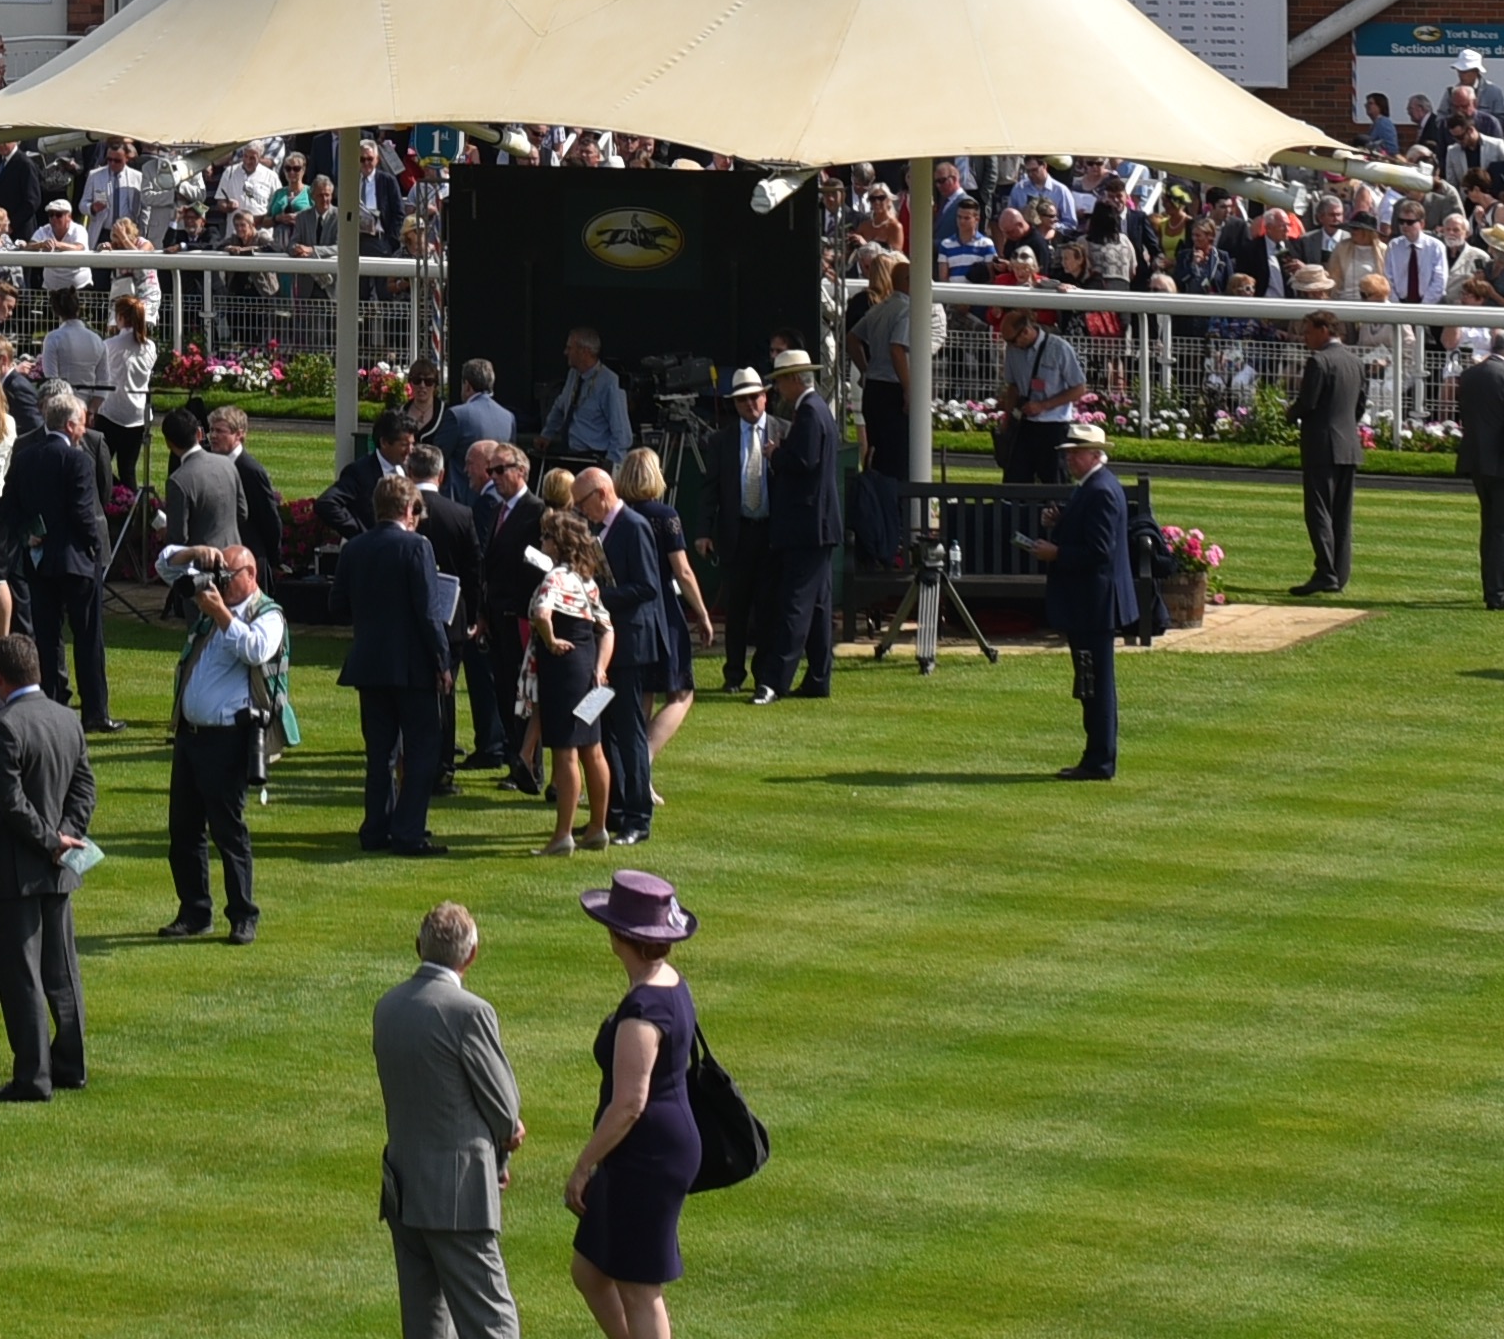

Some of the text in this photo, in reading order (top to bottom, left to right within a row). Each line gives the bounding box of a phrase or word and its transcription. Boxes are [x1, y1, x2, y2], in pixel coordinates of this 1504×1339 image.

[1445, 29, 1500, 40] York Races
[1391, 43, 1446, 55] Sectional
[431, 128, 451, 154] 1st
